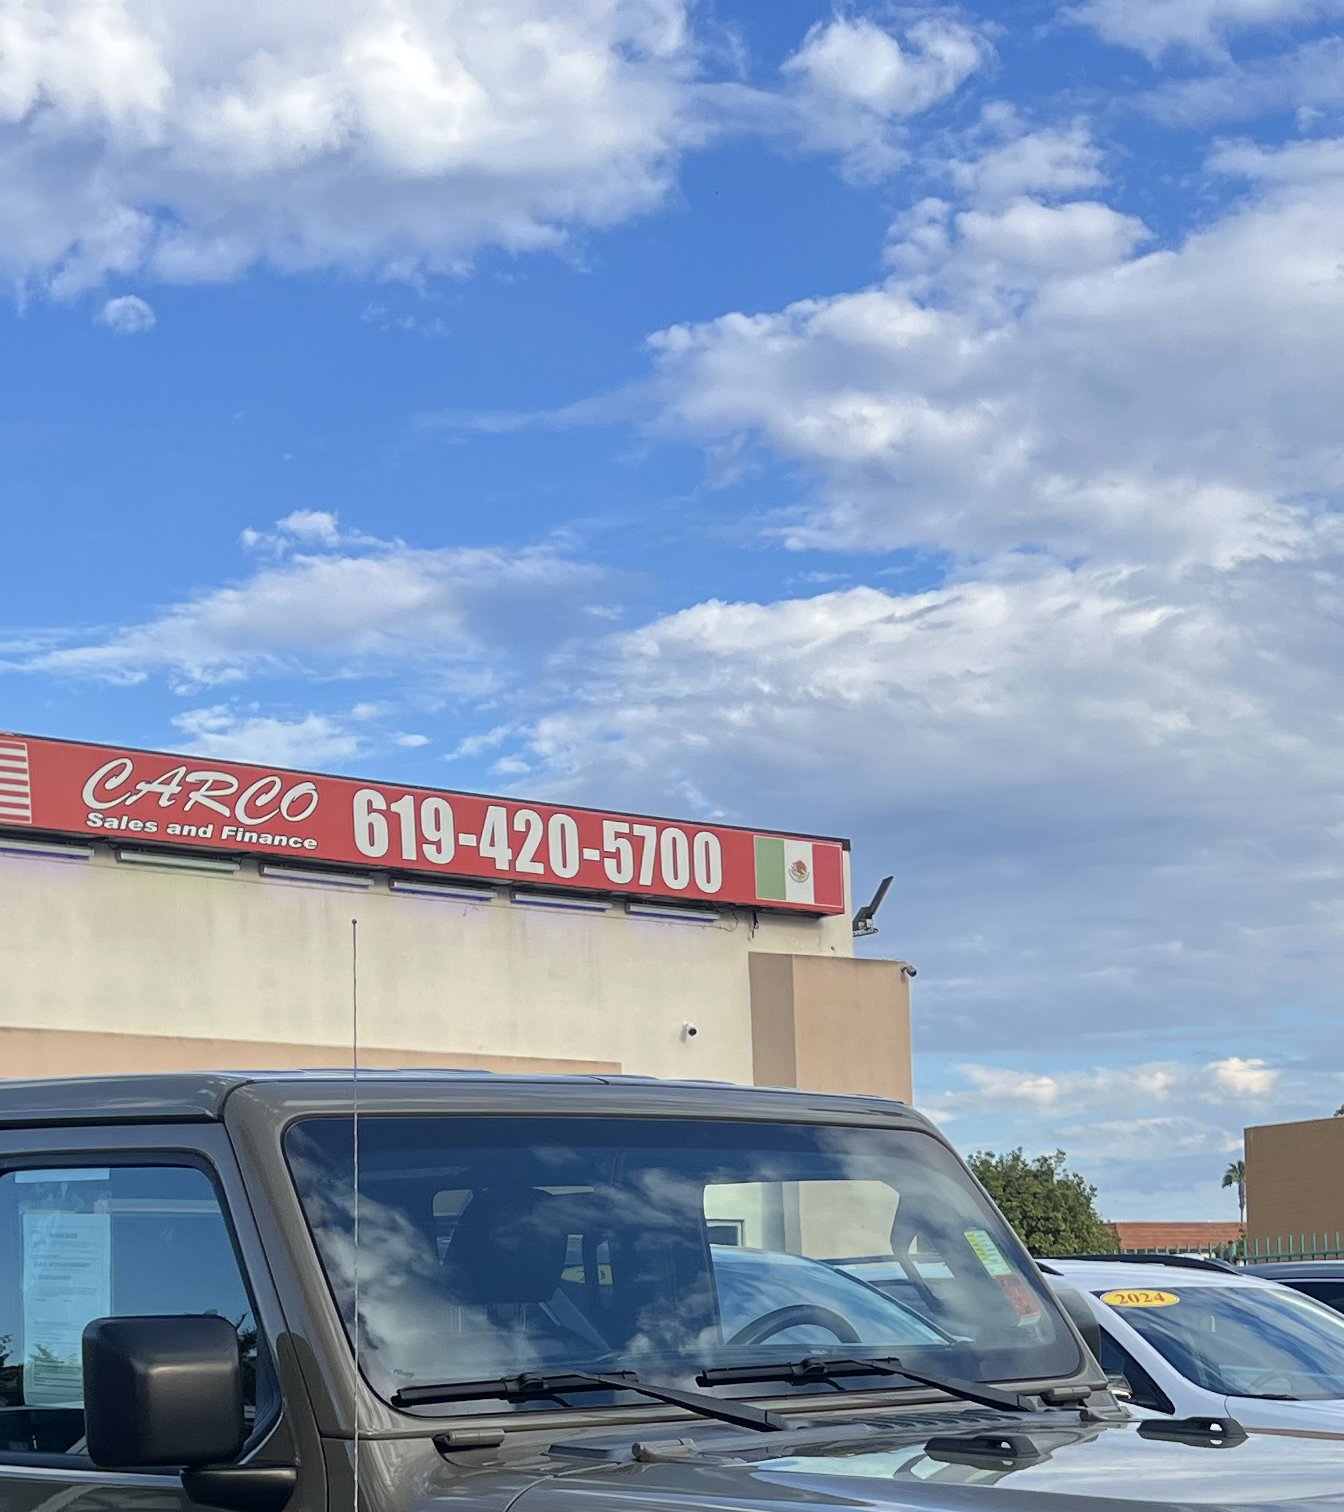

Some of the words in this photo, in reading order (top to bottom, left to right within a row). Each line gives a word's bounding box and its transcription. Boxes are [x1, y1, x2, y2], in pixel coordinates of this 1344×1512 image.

[82, 757, 319, 826] CARCO
[86, 811, 159, 834] Sales
[166, 822, 214, 839] and
[220, 825, 318, 850] Finance
[352, 788, 724, 894] 619-420-5700
[1114, 1292, 1165, 1304] 2024
